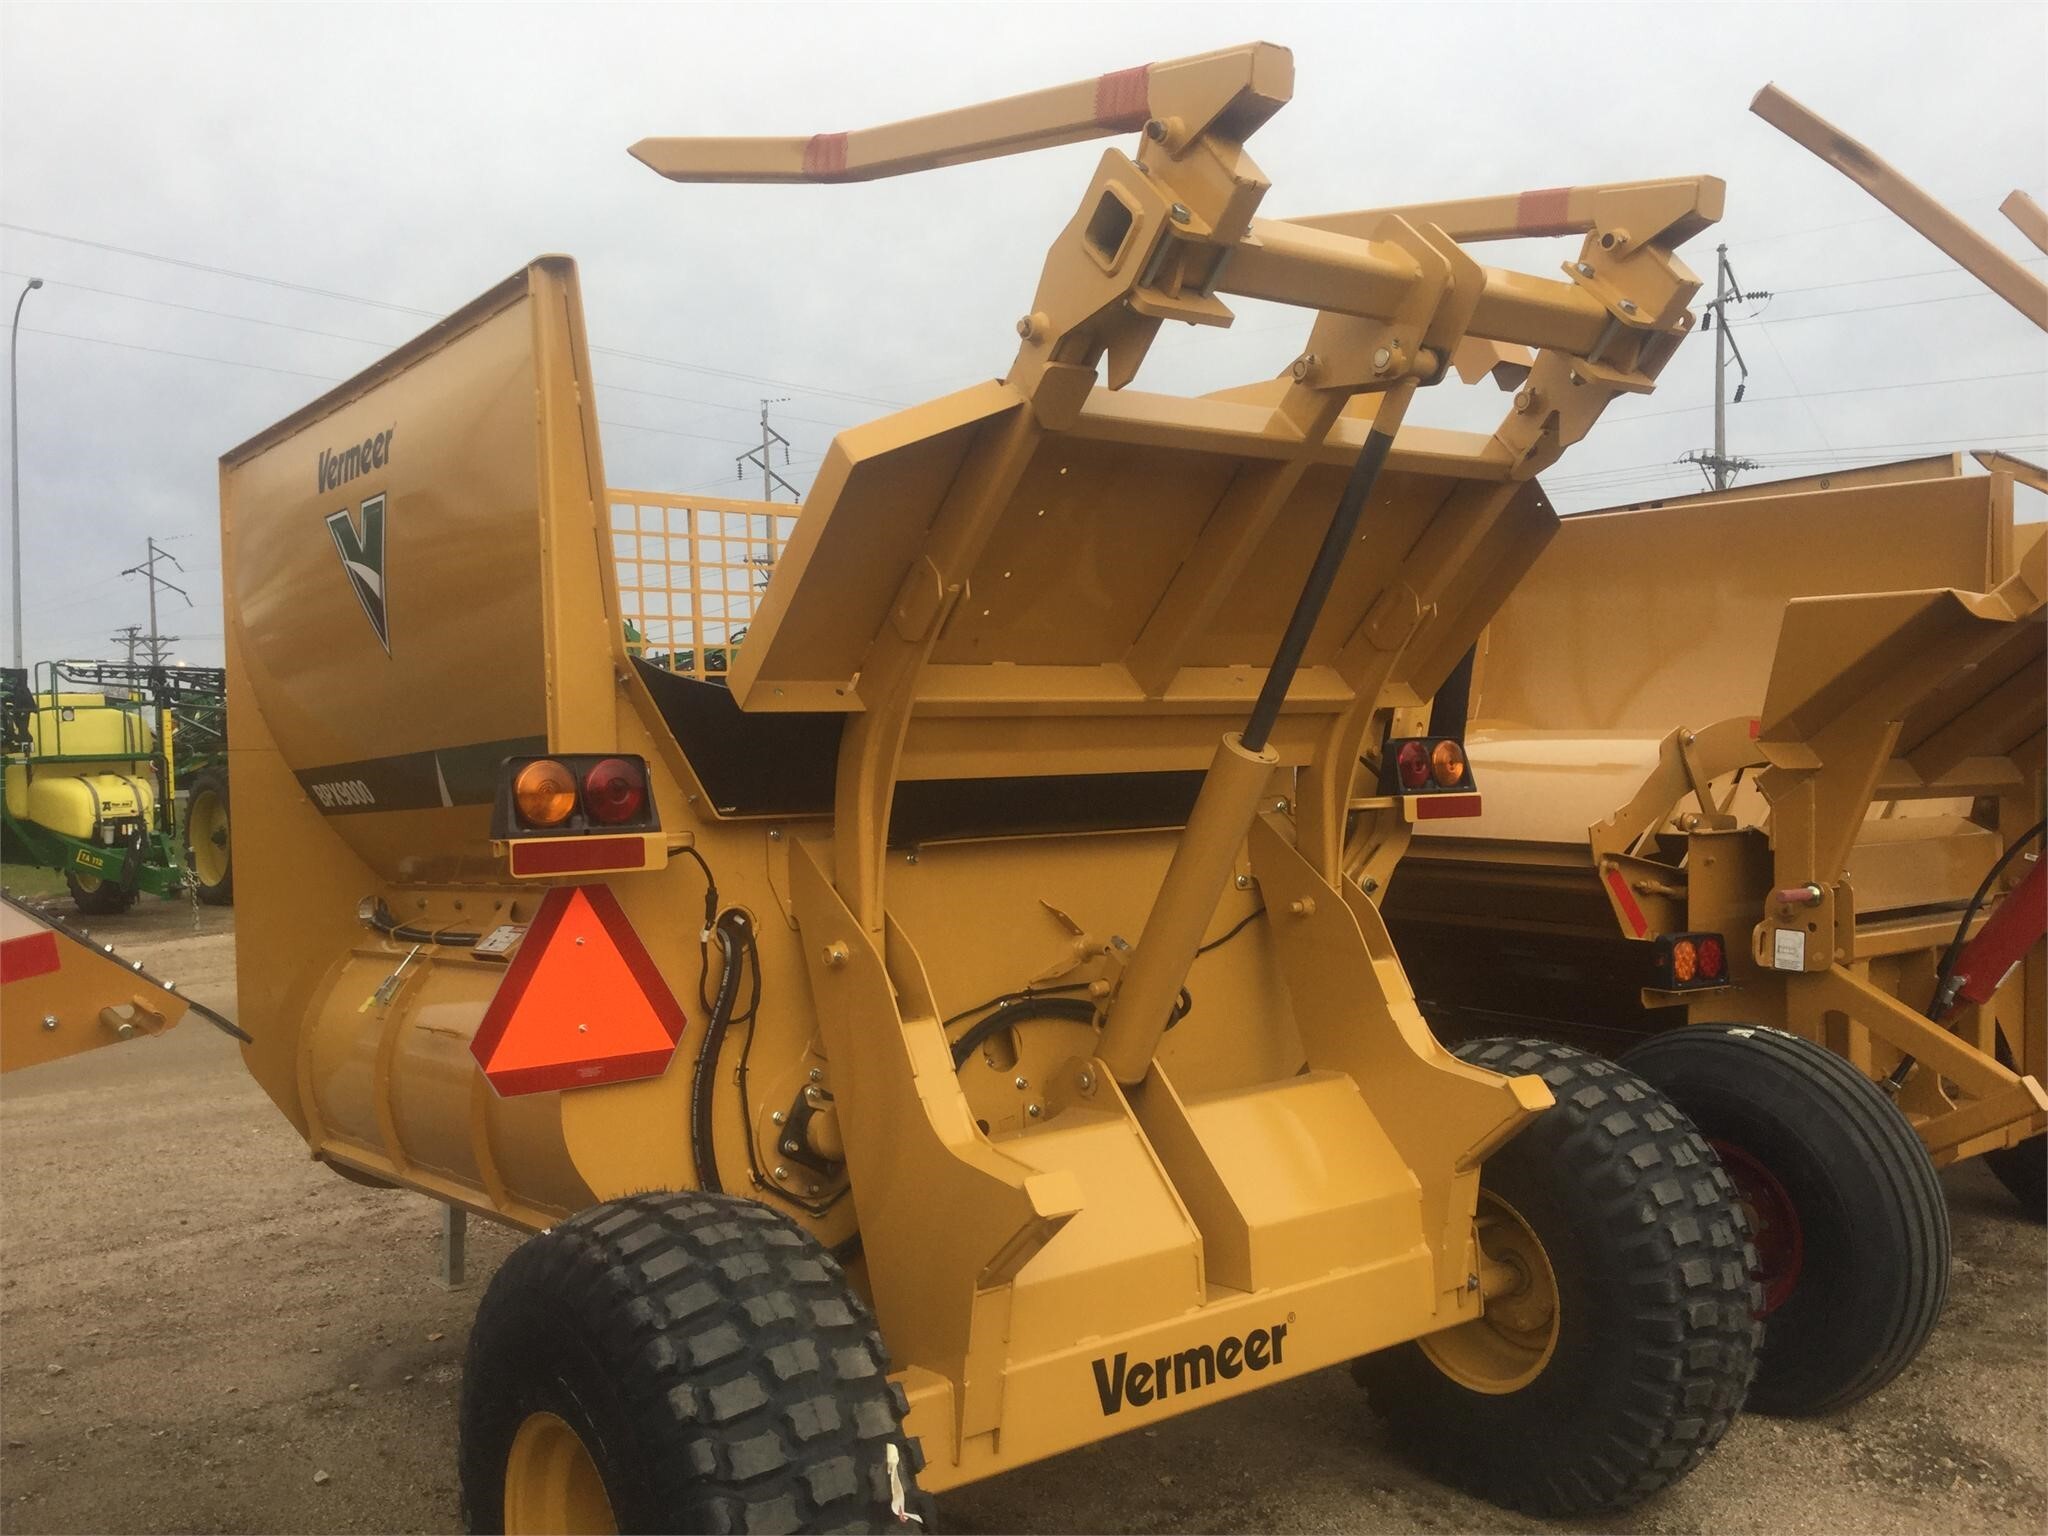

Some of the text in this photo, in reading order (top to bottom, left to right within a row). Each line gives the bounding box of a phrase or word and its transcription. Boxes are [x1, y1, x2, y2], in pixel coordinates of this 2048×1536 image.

[318, 429, 394, 495] Vermeer
[311, 779, 376, 807] BPX9000
[1091, 1323, 1288, 1416] Vermeer
